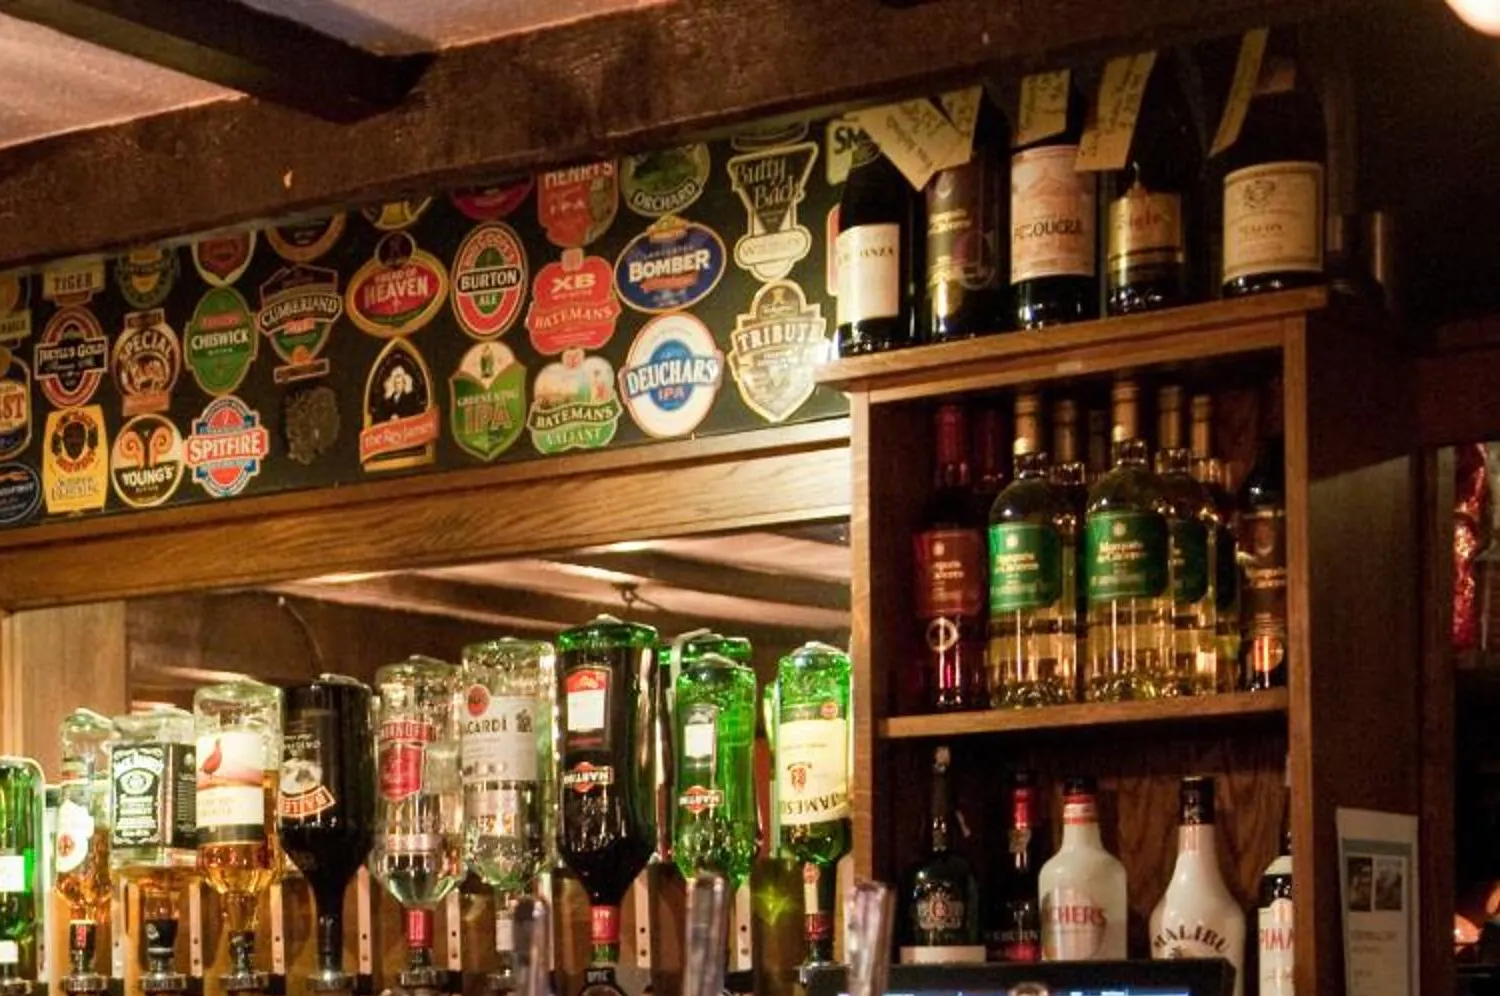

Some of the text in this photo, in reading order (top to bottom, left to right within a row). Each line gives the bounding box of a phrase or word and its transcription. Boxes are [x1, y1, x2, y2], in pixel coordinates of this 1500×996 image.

[460, 269, 518, 291] BURTON
[628, 249, 712, 283] BOMBER
[362, 275, 429, 309] HEAVEN
[552, 272, 596, 291] XB
[119, 331, 172, 360] SPECIAL
[190, 327, 249, 351] CHISWICK
[737, 322, 825, 351] TRIBUTE
[627, 358, 719, 397] DEUCHARS
[189, 430, 263, 464] SPITFIRE
[122, 464, 175, 486] YOUNG'S
[281, 791, 328, 814] BAILE
[786, 792, 841, 815] JAMES
[1153, 924, 1229, 954] MALIBU
